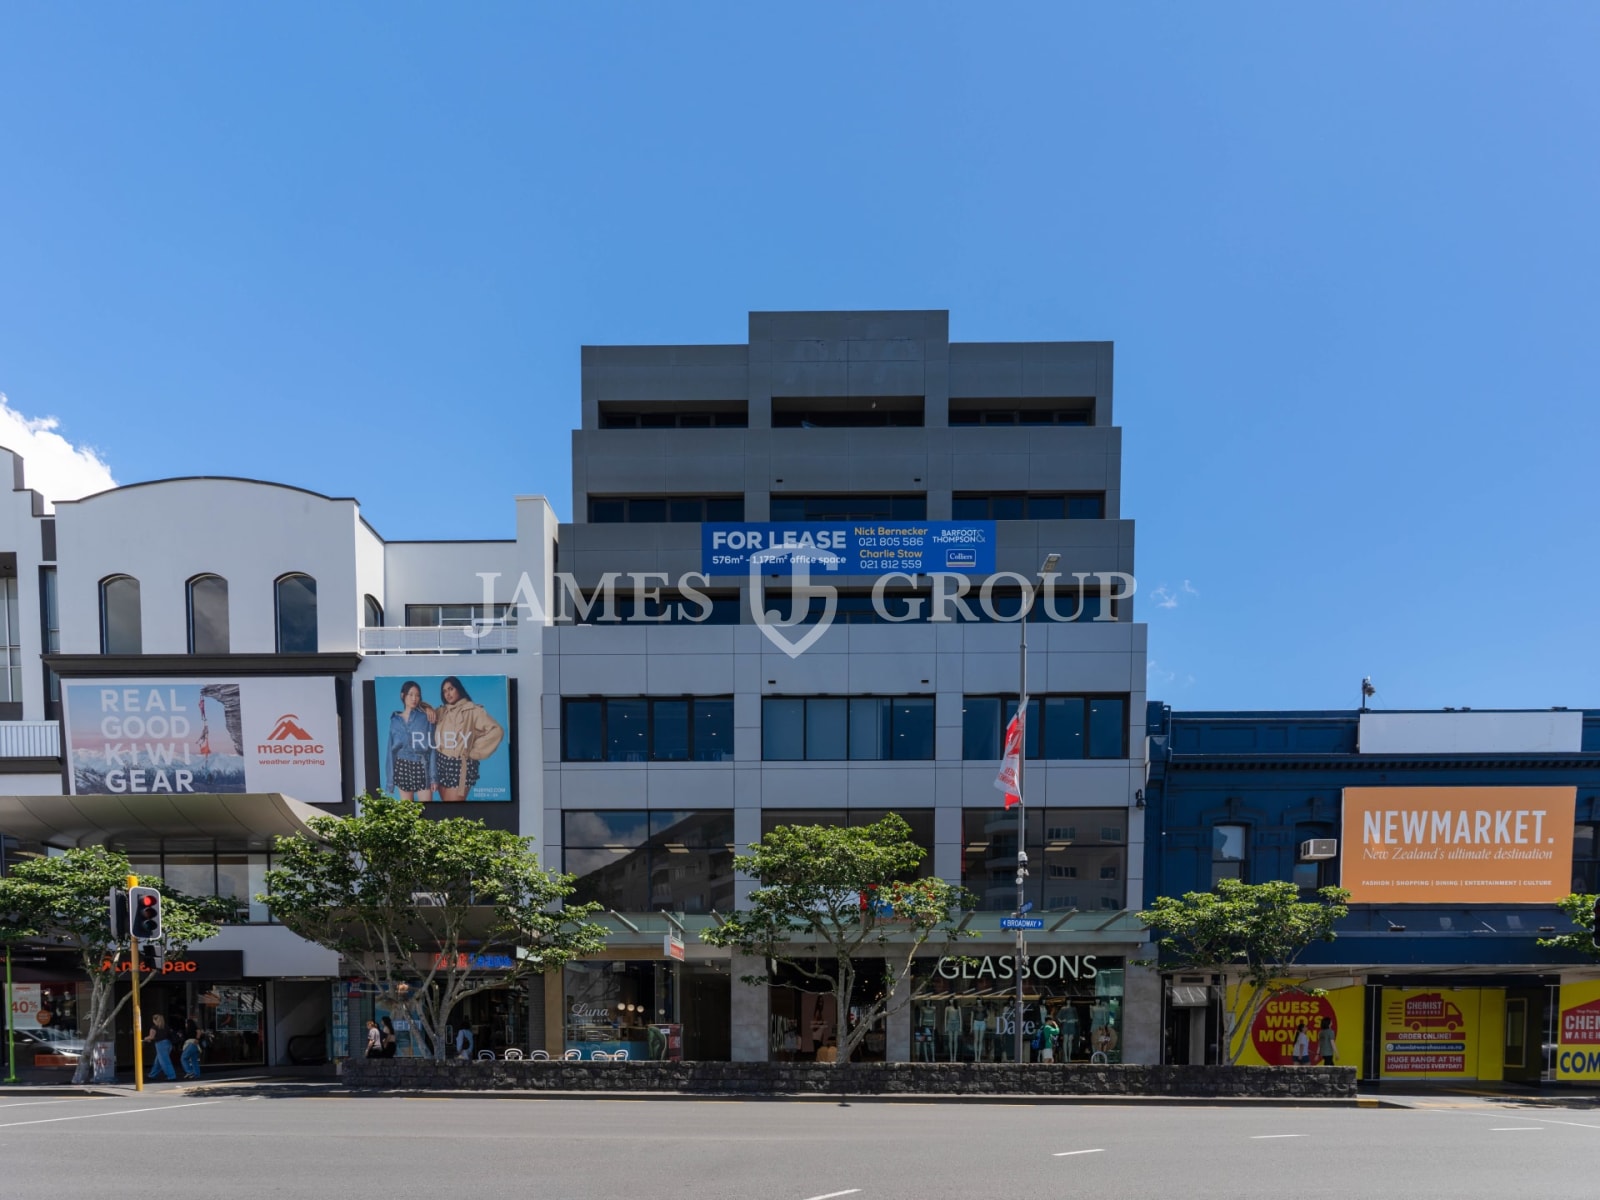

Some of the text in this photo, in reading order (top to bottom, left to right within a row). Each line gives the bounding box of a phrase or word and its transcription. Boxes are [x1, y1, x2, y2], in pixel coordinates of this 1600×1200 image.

[854, 527, 928, 536] Nick Bernecker
[713, 531, 847, 549] FOR LEASE
[858, 537, 924, 547] 021 805 586
[790, 555, 816, 564] office
[818, 556, 847, 566] space
[859, 549, 923, 559] Charlie Stow
[949, 552, 973, 560] Colliers
[859, 560, 922, 569] 021 812 559
[100, 689, 187, 712] REAL
[100, 715, 190, 739] GOOD
[411, 731, 473, 750] RUBY
[105, 743, 191, 766] KIWI
[257, 743, 324, 757] macpac
[292, 758, 325, 767] anything
[105, 769, 195, 793] GEAR
[1363, 810, 1554, 844] NEWMARKET.
[1362, 847, 1553, 861] New Zealand's ultimate destination
[122, 960, 197, 975] mapac
[937, 955, 1098, 979] GLASSONS
[571, 1002, 610, 1017] Luna
[1266, 1001, 1319, 1014] GUESS
[1407, 1001, 1442, 1009] CHEMIST
[1265, 1015, 1323, 1028] WHO'S
[1259, 1029, 1321, 1042] MOVN
[1560, 1051, 1600, 1073] COM
